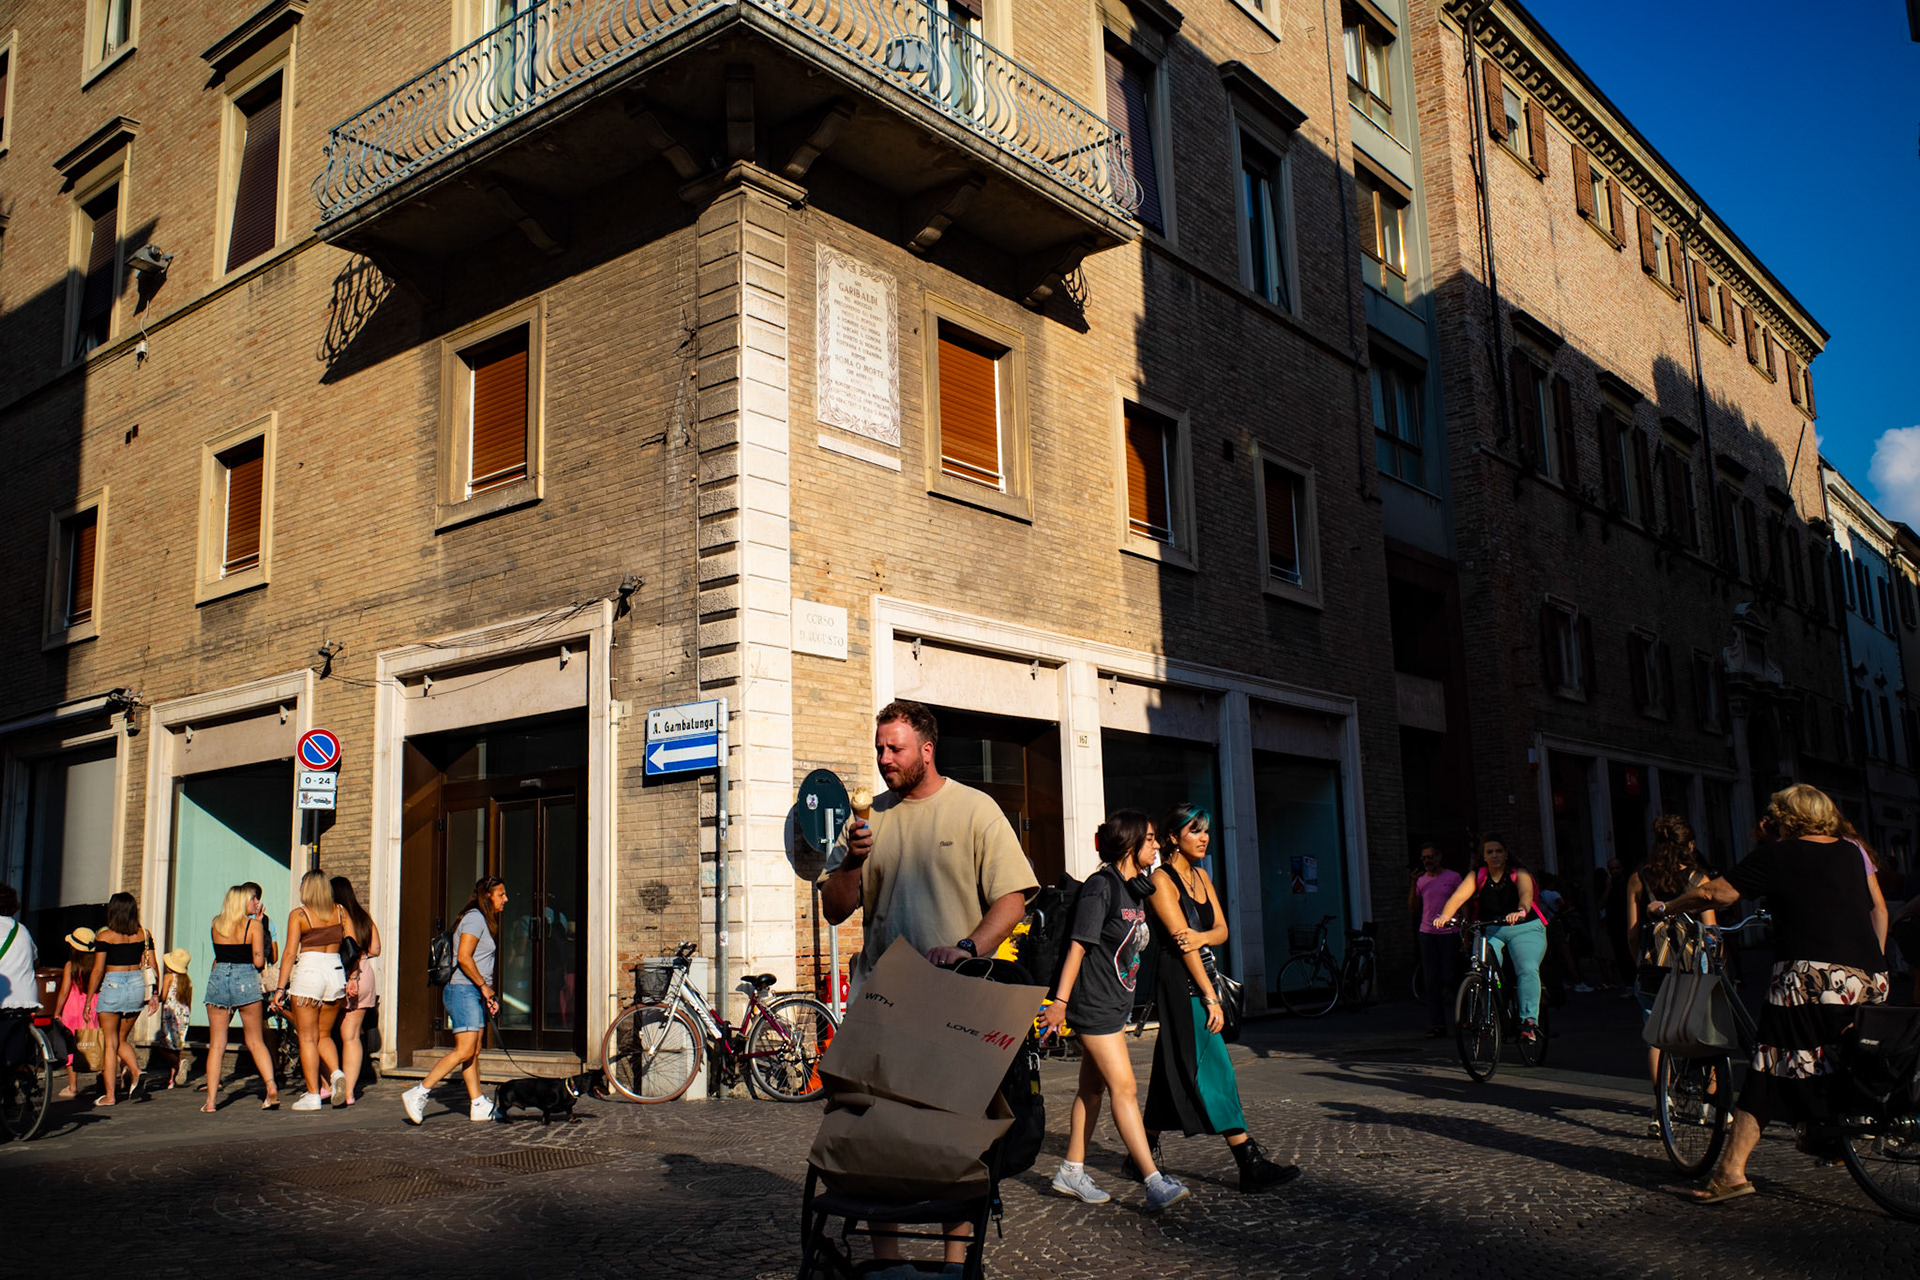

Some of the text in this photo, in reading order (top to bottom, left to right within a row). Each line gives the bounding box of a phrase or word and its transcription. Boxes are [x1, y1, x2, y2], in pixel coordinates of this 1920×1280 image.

[838, 282, 877, 306] GARIBALDI
[835, 354, 853, 367] ROMA
[864, 365, 884, 378] MORTE
[806, 613, 834, 627] CORSO
[653, 718, 714, 734] A. Gambalunga
[865, 992, 1016, 1050] WITH LOVE H&M
